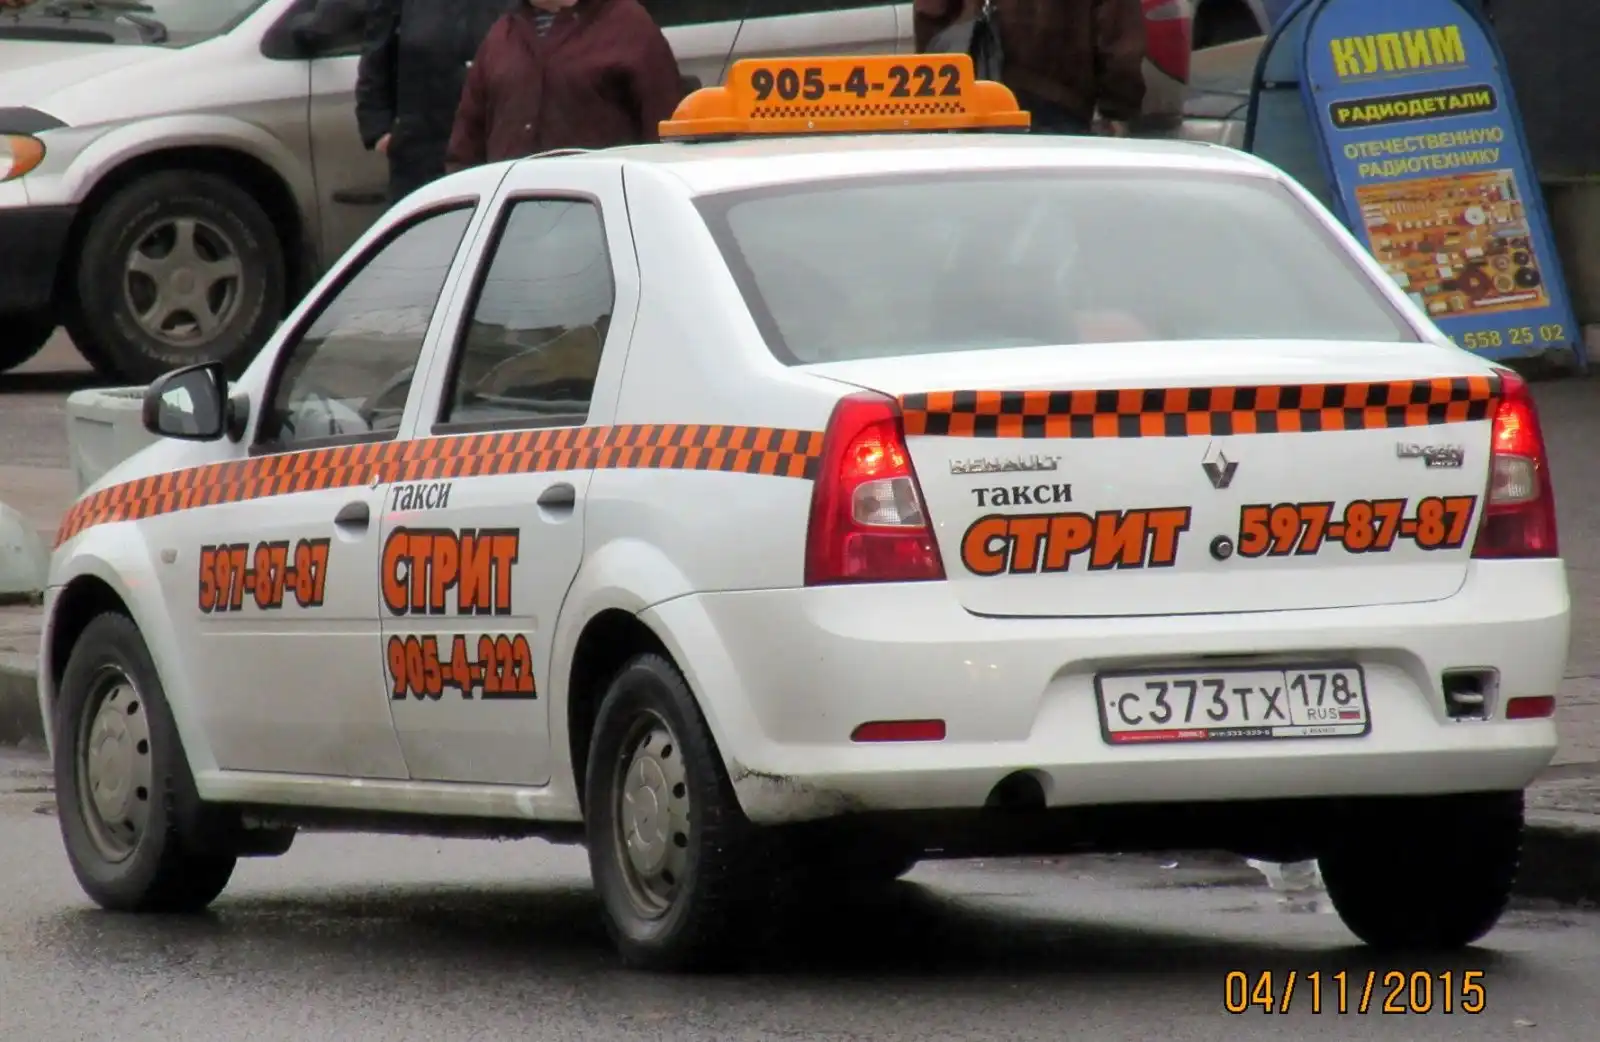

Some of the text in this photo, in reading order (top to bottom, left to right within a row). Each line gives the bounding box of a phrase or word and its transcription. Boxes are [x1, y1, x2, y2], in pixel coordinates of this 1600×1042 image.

[1330, 25, 1466, 77] КУПИМ
[751, 64, 961, 100] 905-4-222
[1337, 91, 1491, 122] РАДИОДЕТАЛИ
[1343, 128, 1504, 160] ОТЕЧЕСТВЕННУЮ
[1358, 149, 1500, 178] РАДИОТЕХНИКУ
[1463, 330, 1502, 349] 558
[1508, 326, 1534, 345] 25
[1539, 324, 1565, 342] 02
[948, 455, 1062, 475] RENAULT
[392, 483, 452, 510] такси
[971, 484, 1073, 507] такси
[960, 495, 1478, 576] СТРИТ 597-87-87
[198, 538, 331, 614] 597-87-87
[381, 526, 520, 616] СТРИТ
[387, 634, 537, 700] 905-4-222
[1290, 673, 1352, 706] 178
[1307, 707, 1338, 720] RUS
